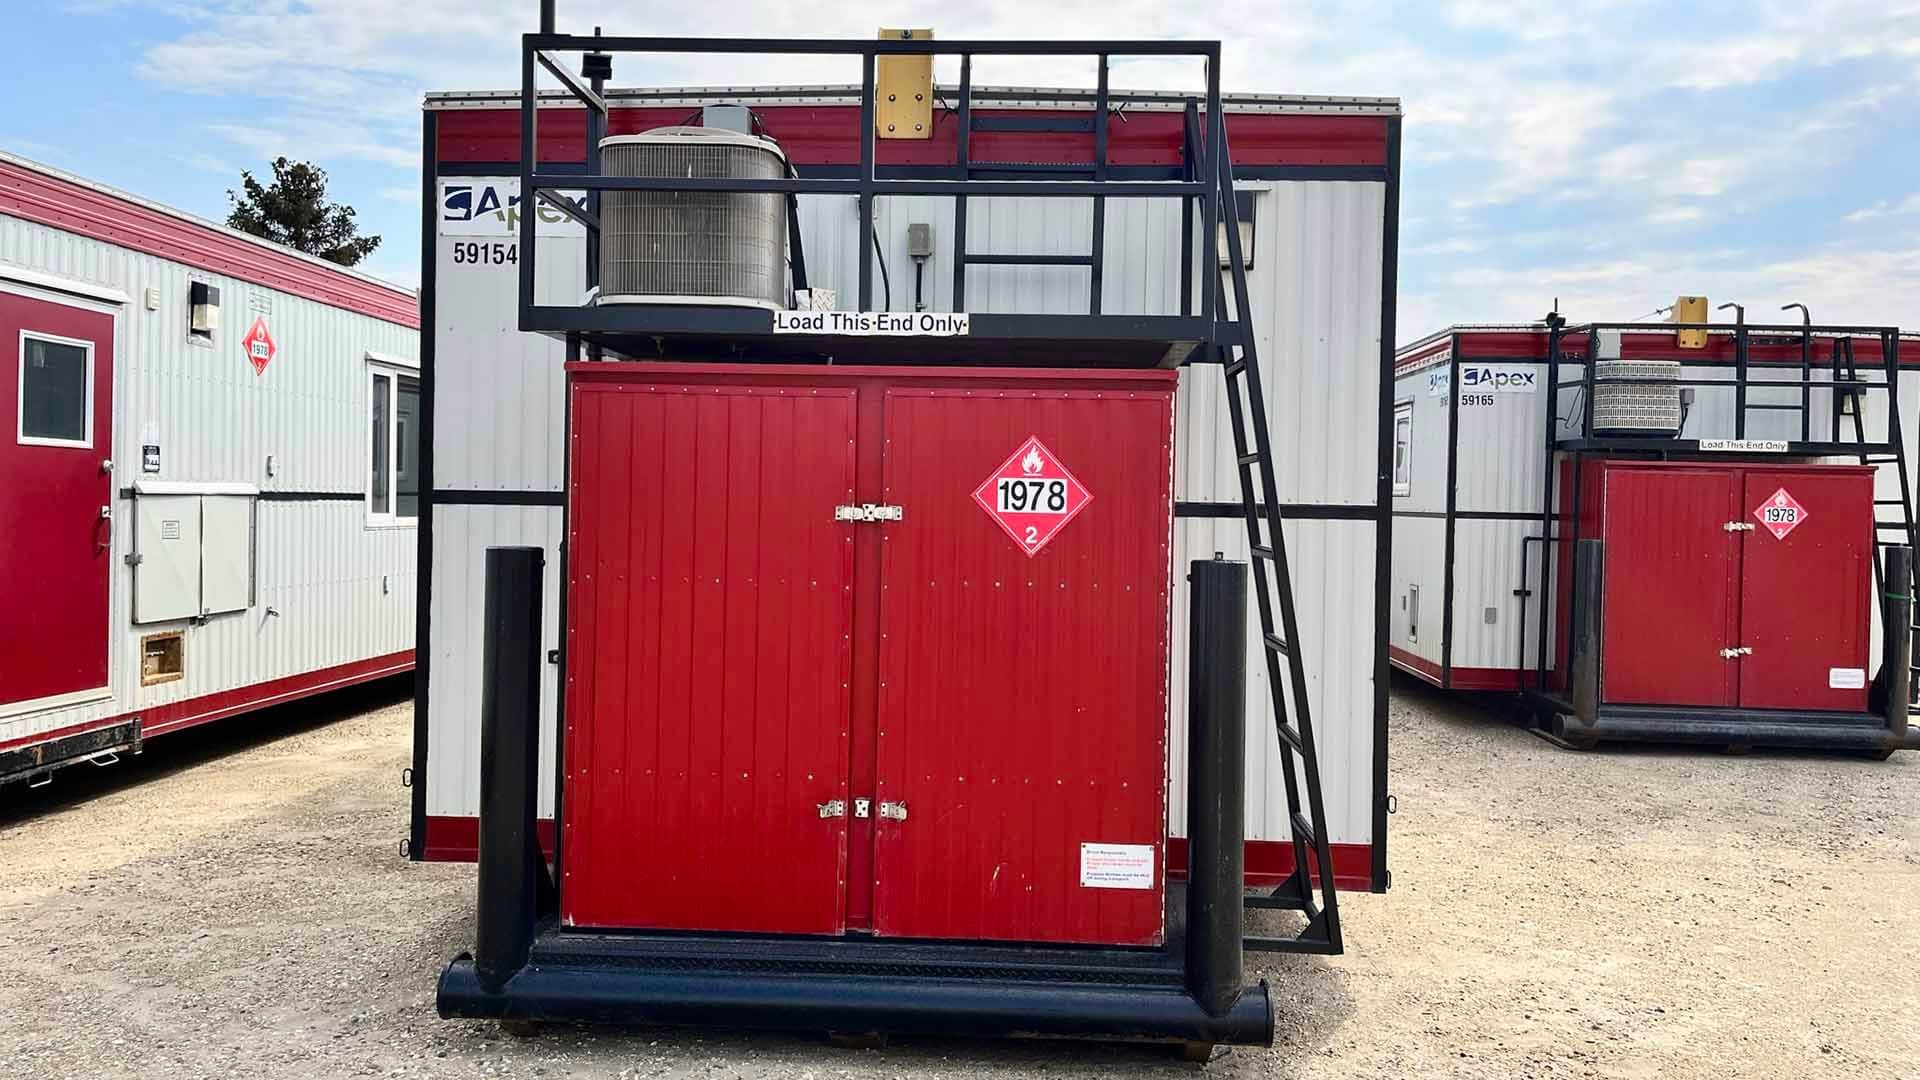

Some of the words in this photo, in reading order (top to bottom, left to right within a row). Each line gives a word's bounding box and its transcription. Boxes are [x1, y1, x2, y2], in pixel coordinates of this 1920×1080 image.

[454, 243, 518, 264] 59154
[778, 313, 824, 330] Load
[830, 313, 870, 331] This
[877, 314, 913, 331] End
[920, 314, 965, 333] Only
[1479, 368, 1536, 389] Apex
[1462, 395, 1494, 406] 59165
[1701, 440, 1724, 449] Load
[1726, 441, 1744, 449] This
[1746, 441, 1764, 449] End
[1765, 441, 1786, 451] Only
[999, 480, 1065, 511] 1978
[1766, 508, 1795, 522] 1978
[1025, 526, 1038, 544] 2
